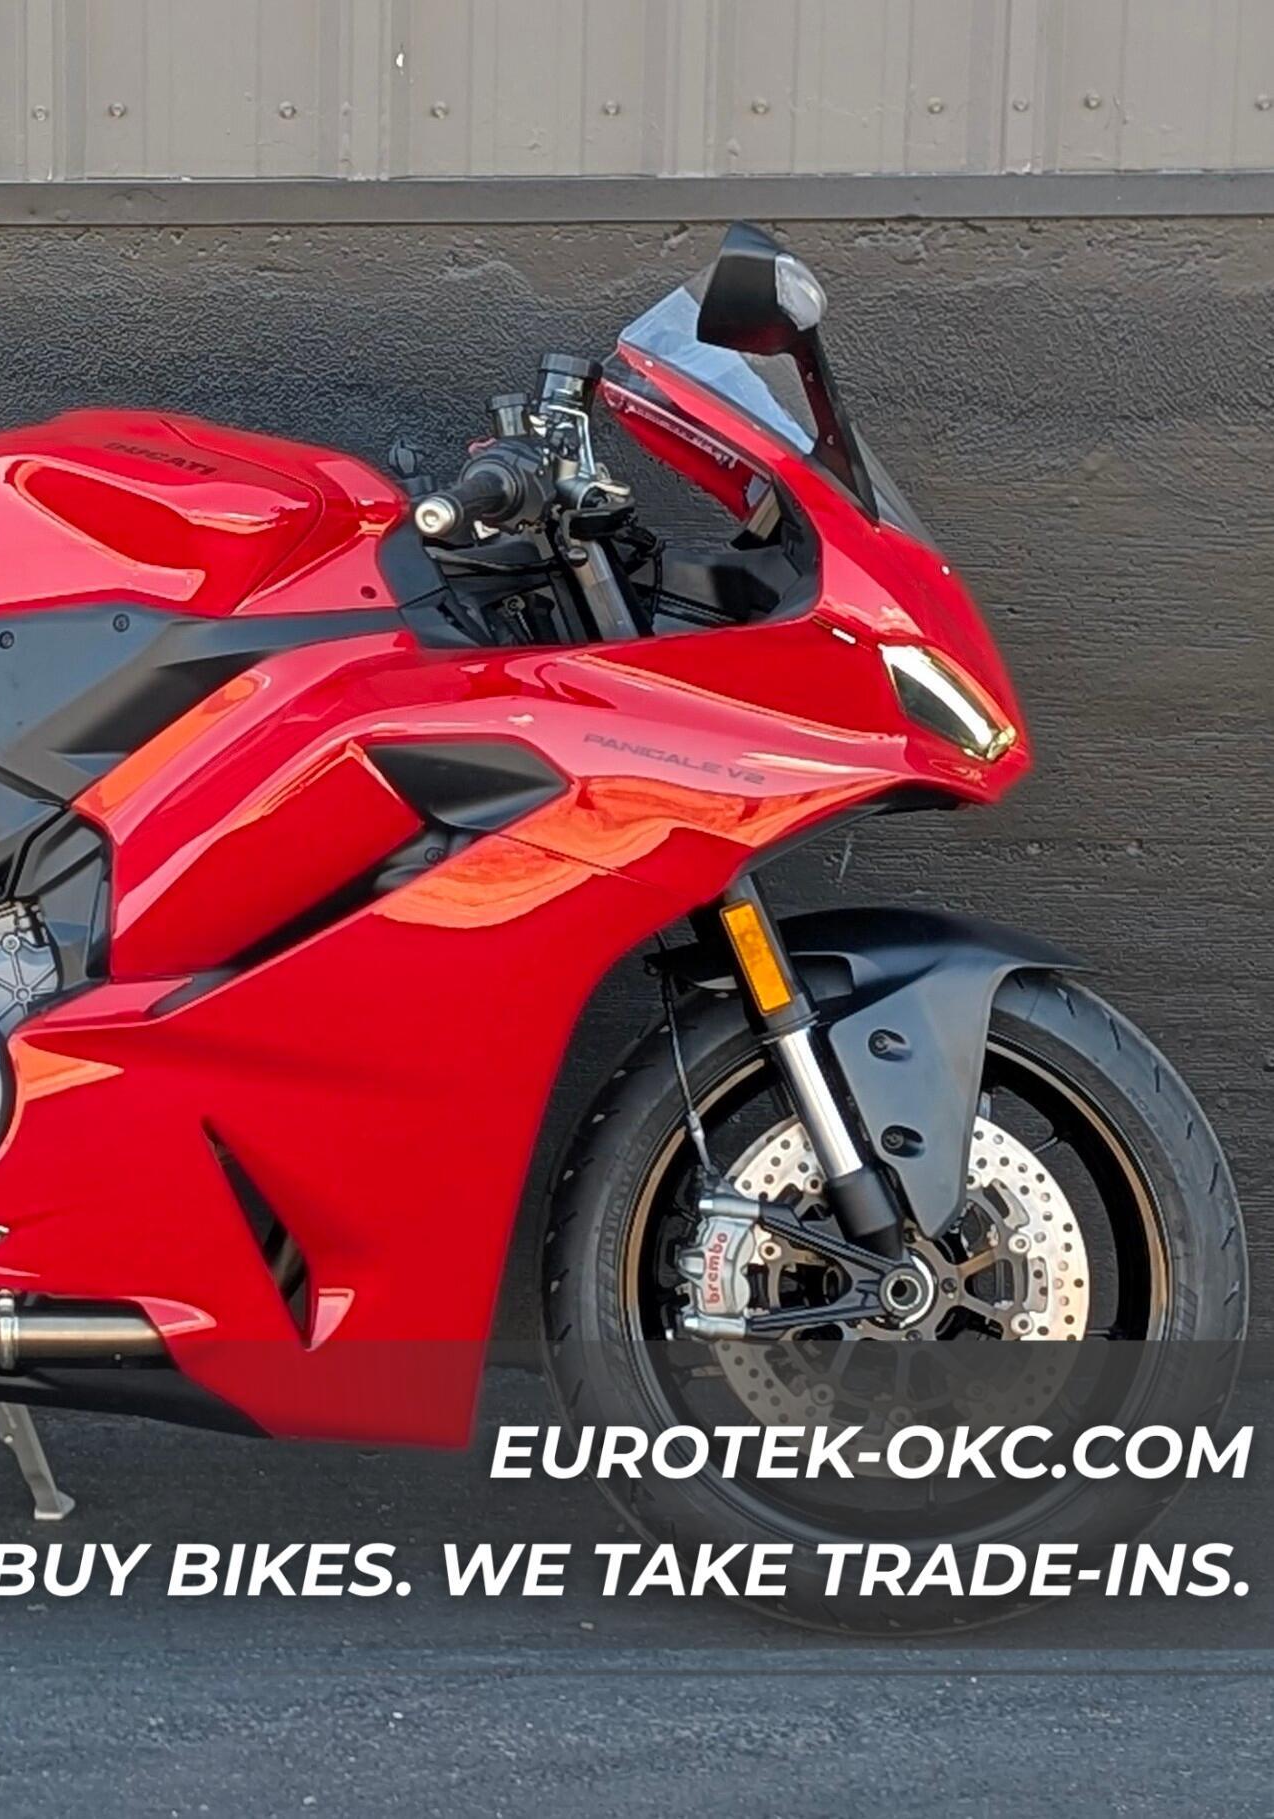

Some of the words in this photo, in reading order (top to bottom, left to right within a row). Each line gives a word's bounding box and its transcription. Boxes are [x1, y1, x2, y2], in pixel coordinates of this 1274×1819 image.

[104, 442, 218, 475] DUCATI
[583, 733, 723, 774] PANIGALE
[728, 767, 765, 785] V2
[706, 1232, 728, 1304] brembo
